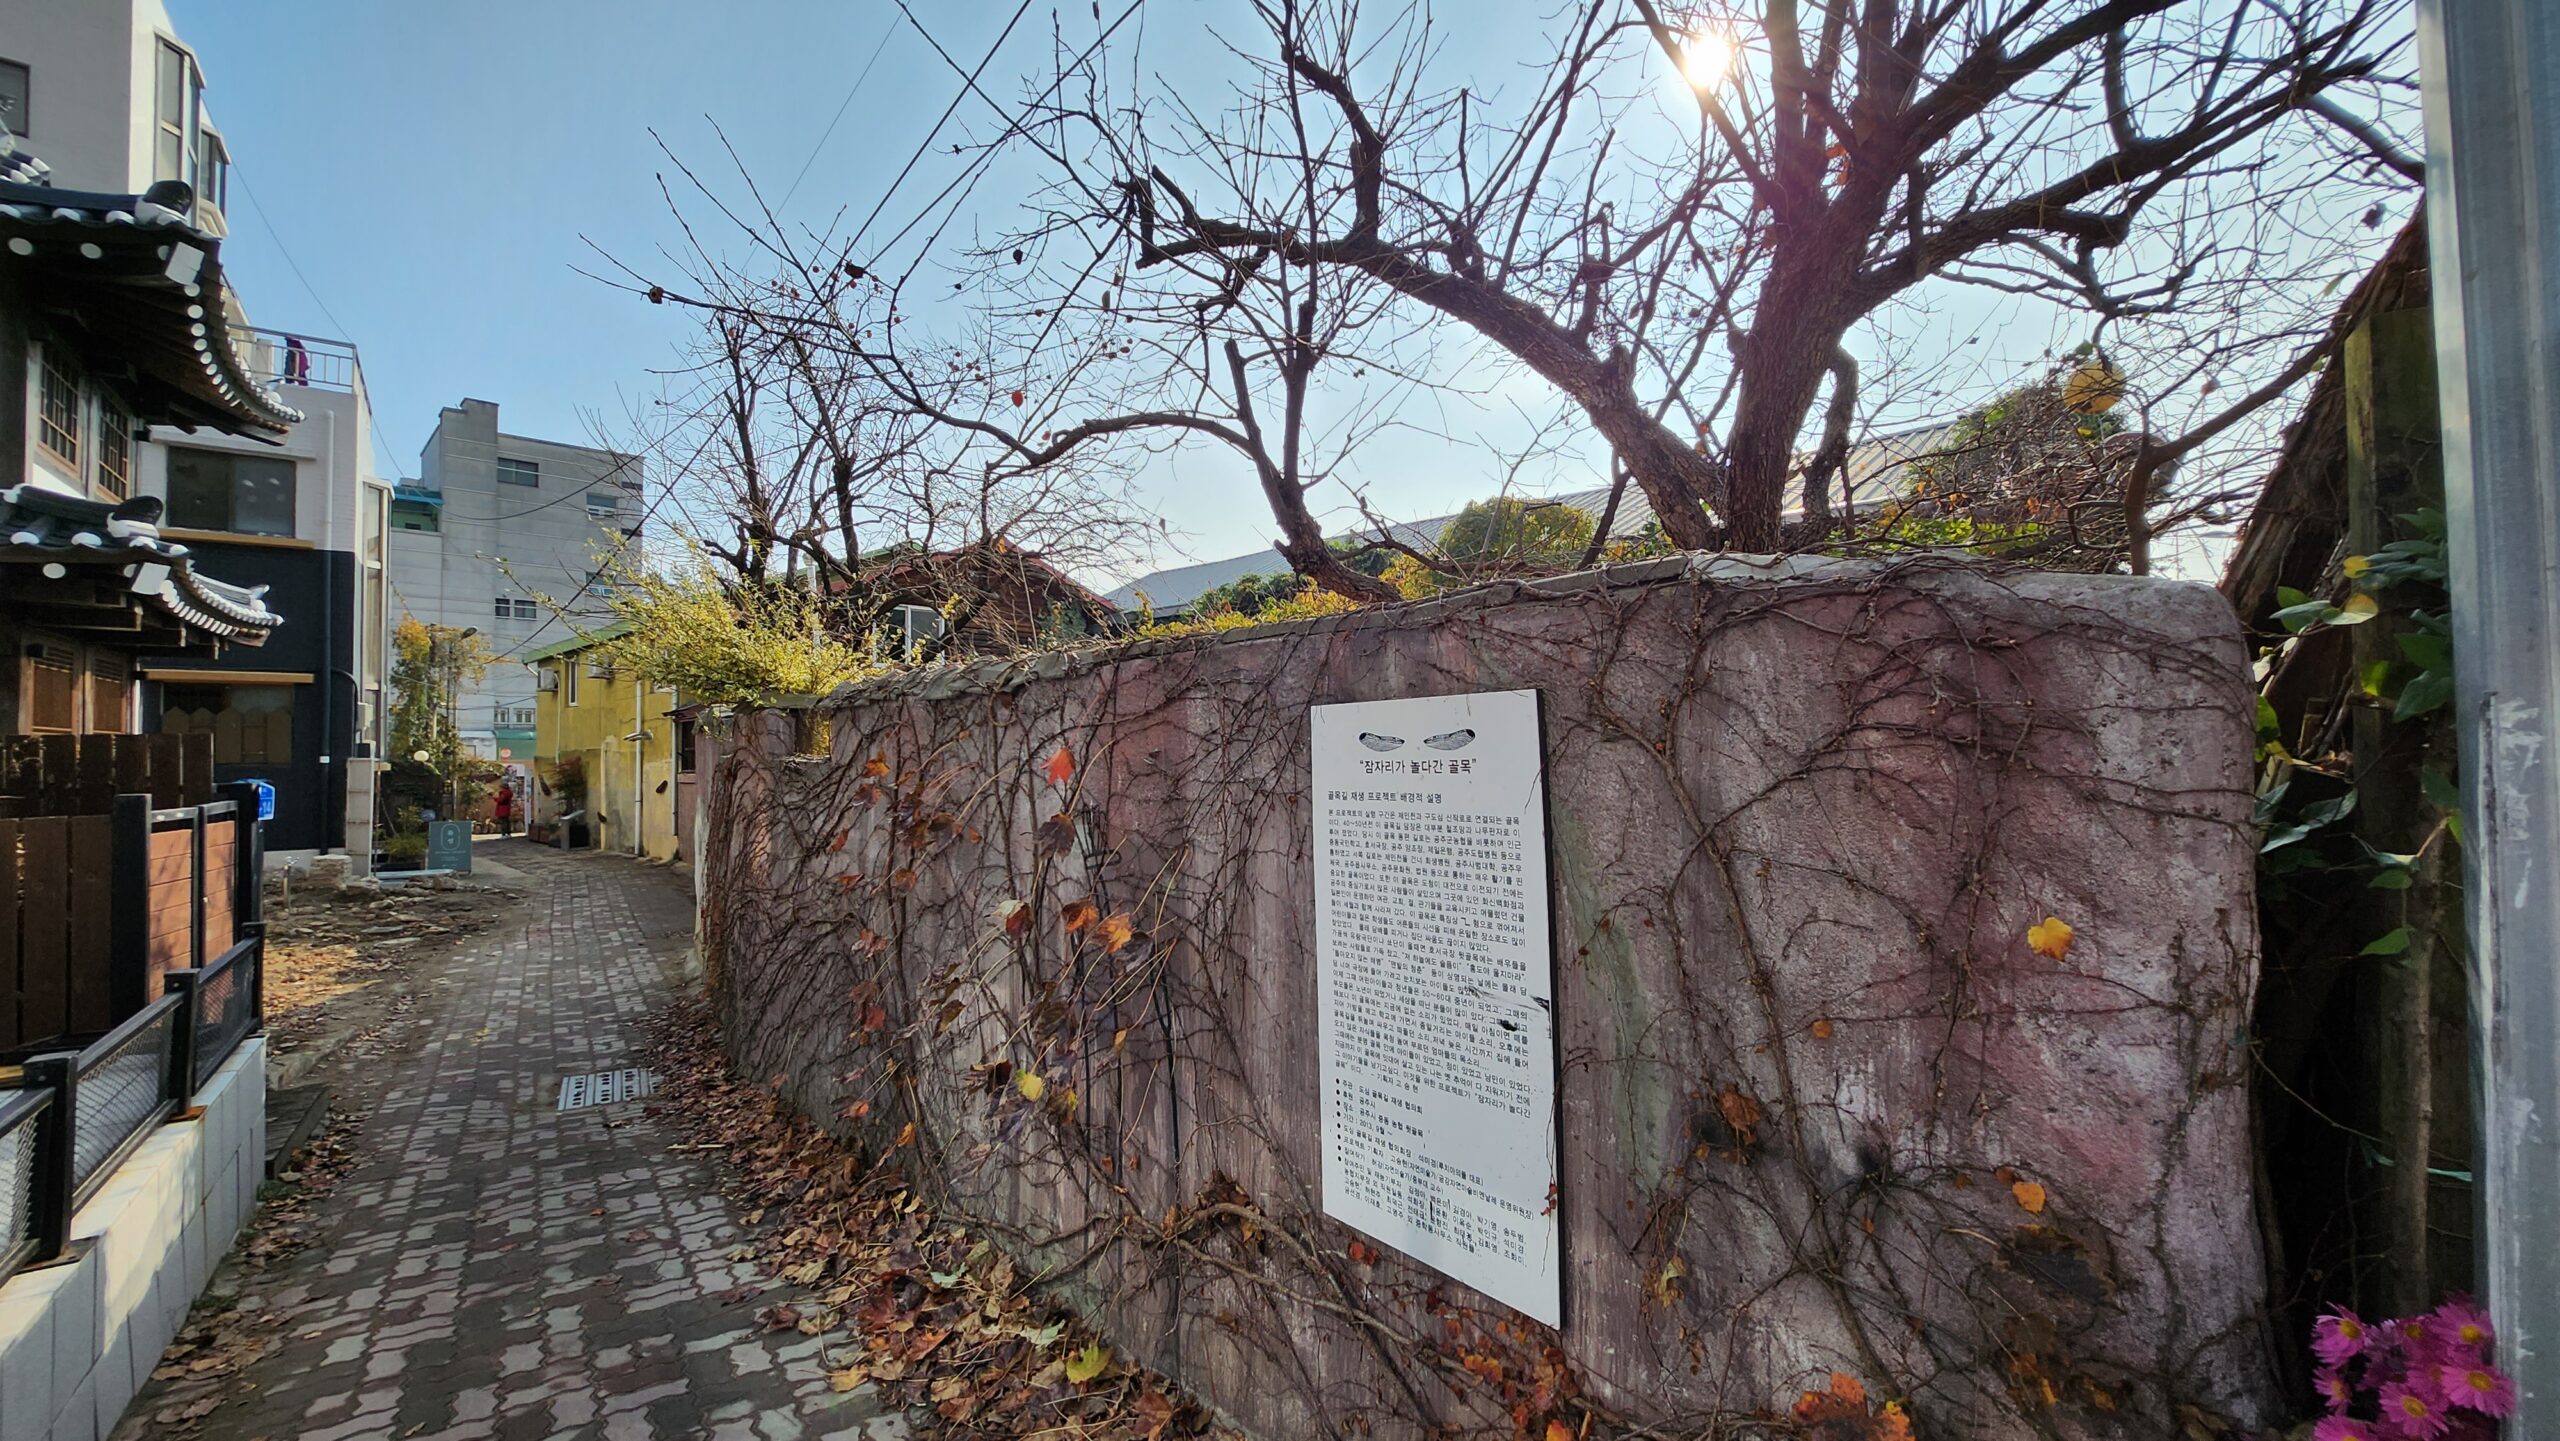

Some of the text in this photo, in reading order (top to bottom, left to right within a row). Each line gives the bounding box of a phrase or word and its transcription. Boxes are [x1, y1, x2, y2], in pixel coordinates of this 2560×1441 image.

[1360, 758, 1476, 774] “잠자리가 놀다간 골목”
[1328, 790, 1441, 804] 골목길 재생 프로젝트 배경적 설명
[1335, 809, 1362, 817] 프로젝트의
[1378, 810, 1395, 819] 구간은
[1424, 812, 1443, 822] 구도심
[1474, 815, 1502, 825] 연결되는
[1505, 816, 1519, 825] 골목
[1383, 821, 1401, 830] 골목길
[1403, 822, 1421, 831] 담장은
[1424, 823, 1443, 833] 대부분
[1474, 826, 1509, 836] 나무판자로
[1512, 828, 1520, 838] 이
[1391, 842, 1402, 851] 공주
[1500, 851, 1521, 861] 등으로
[1506, 839, 1521, 849] 인근
[1501, 863, 1522, 873] 공주우
[1442, 881, 1468, 891] 대전으로
[1502, 887, 1523, 899] 전에는
[1481, 932, 1508, 944] 장소로도
[1511, 937, 1525, 947] 많이
[1431, 968, 1443, 979] 등이
[1519, 986, 1527, 996] 담
[1464, 1045, 1492, 1059] 시간까지
[1499, 1041, 1528, 1057] 오후에는
[1475, 1082, 1482, 1091] 다
[1515, 1094, 1530, 1106] 전에
